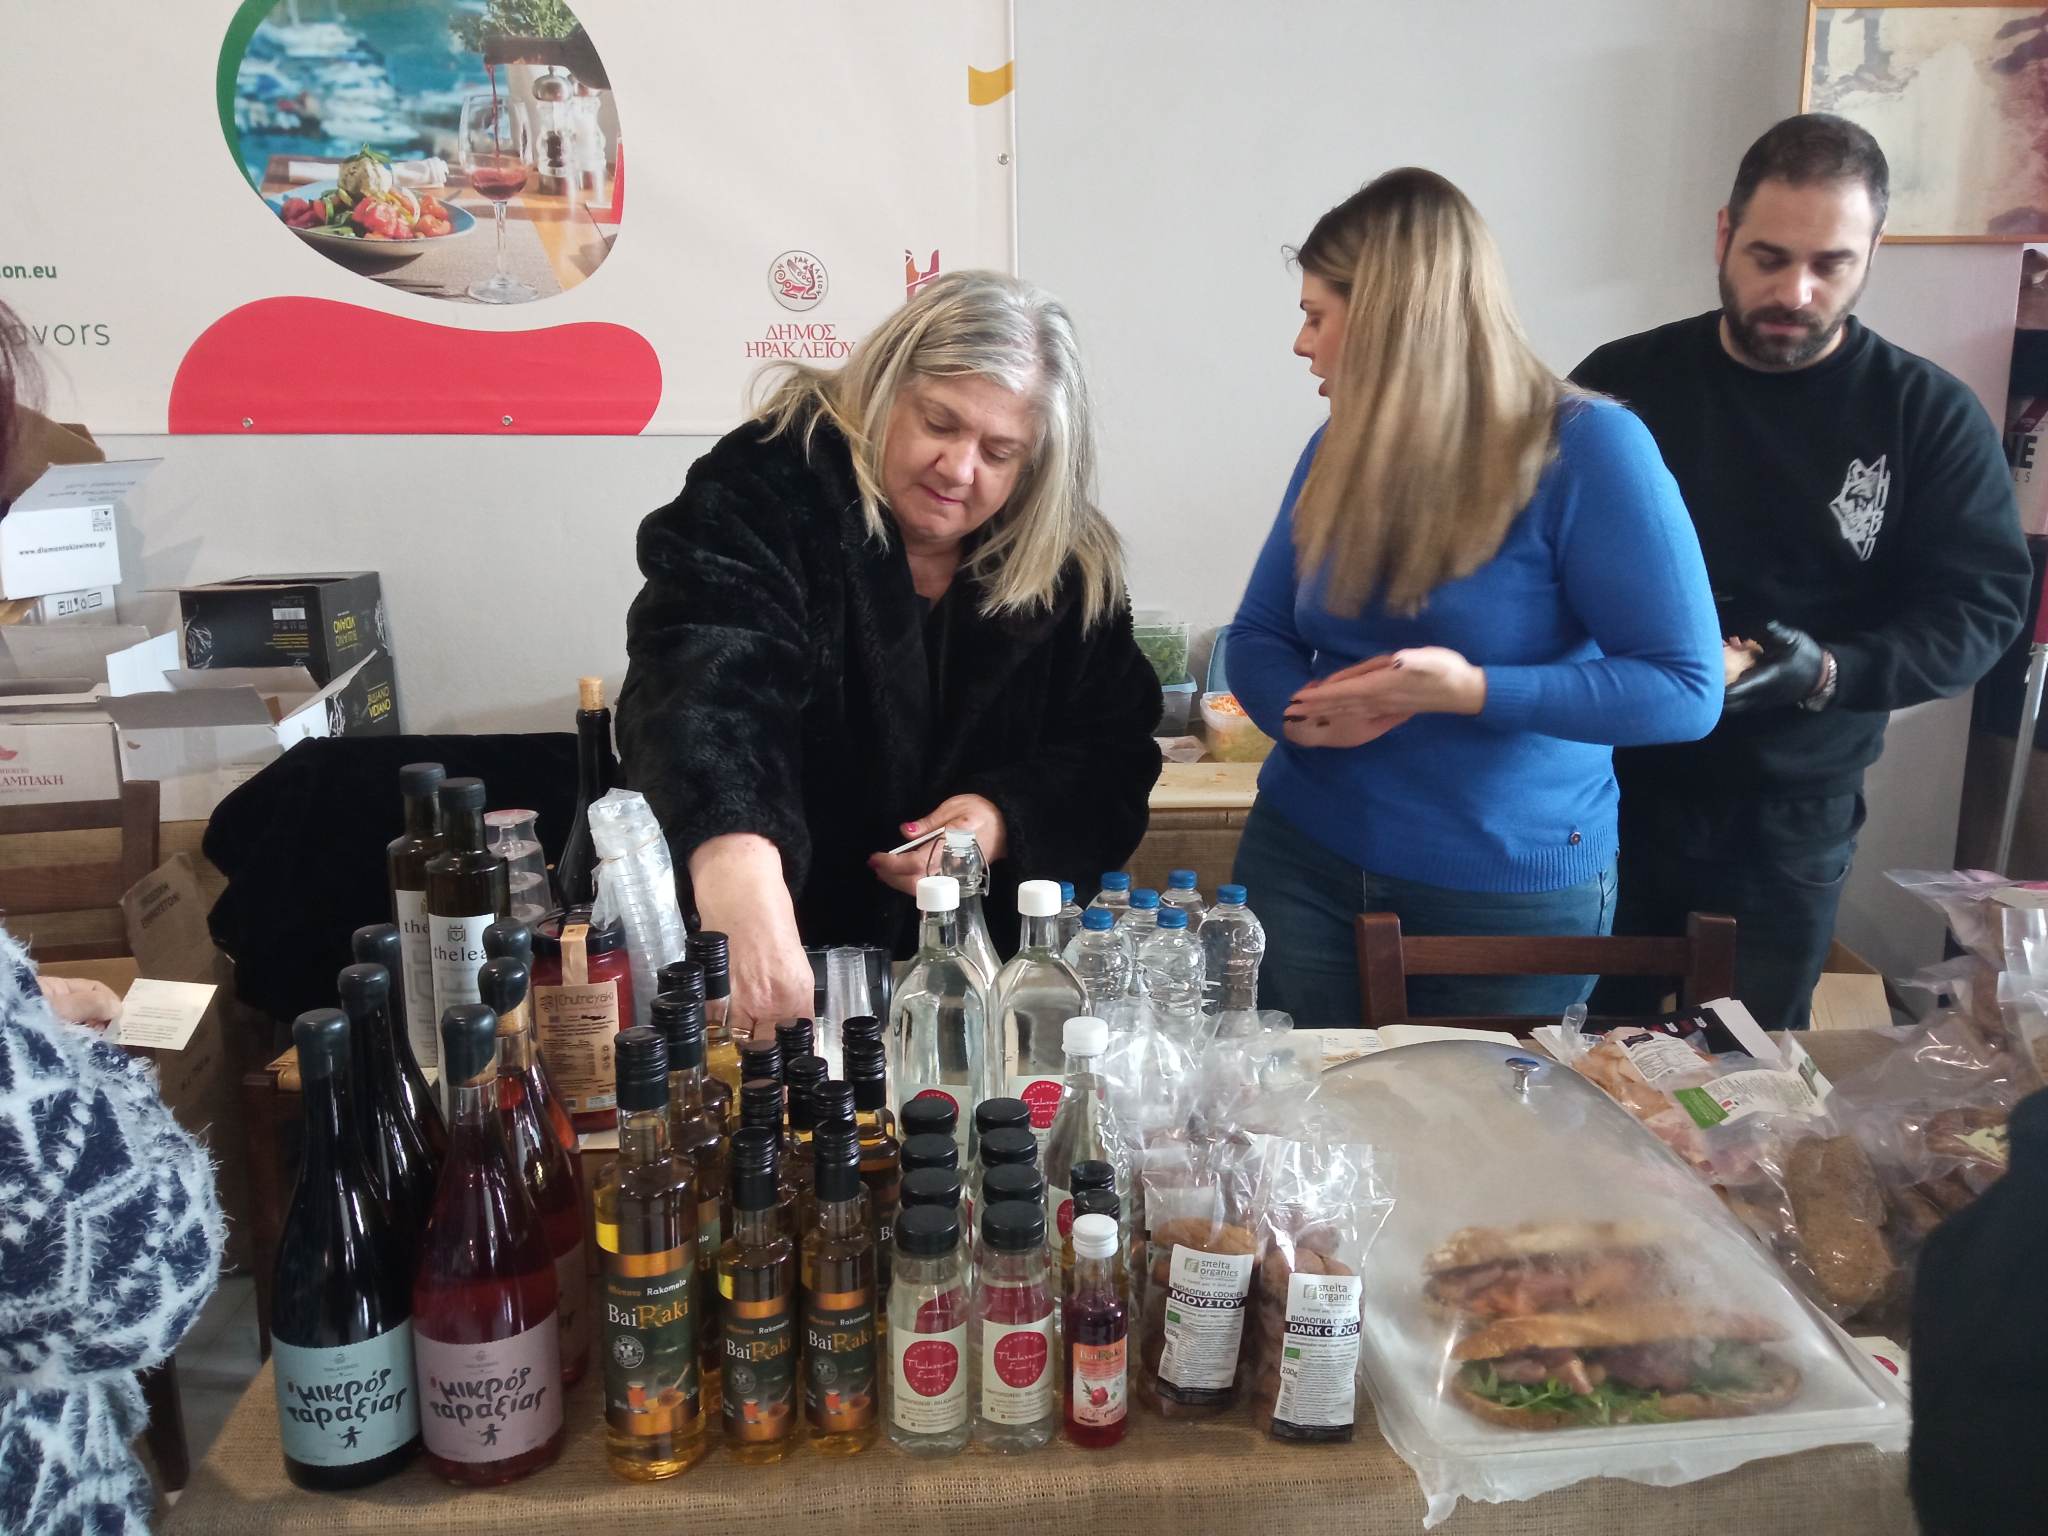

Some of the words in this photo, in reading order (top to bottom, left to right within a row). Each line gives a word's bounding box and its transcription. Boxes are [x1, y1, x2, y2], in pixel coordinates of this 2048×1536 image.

[766, 323, 836, 341] ΔΗΜΟΣ
[746, 341, 856, 359] ΗΡΑΚΛΕΙΟΥ
[646, 1279, 687, 1297] Rakomelo
[1171, 1290, 1243, 1308] ΜΟΥΣΤΟΥ
[1289, 1324, 1322, 1336] DARK
[1324, 1324, 1358, 1337] CHOCO
